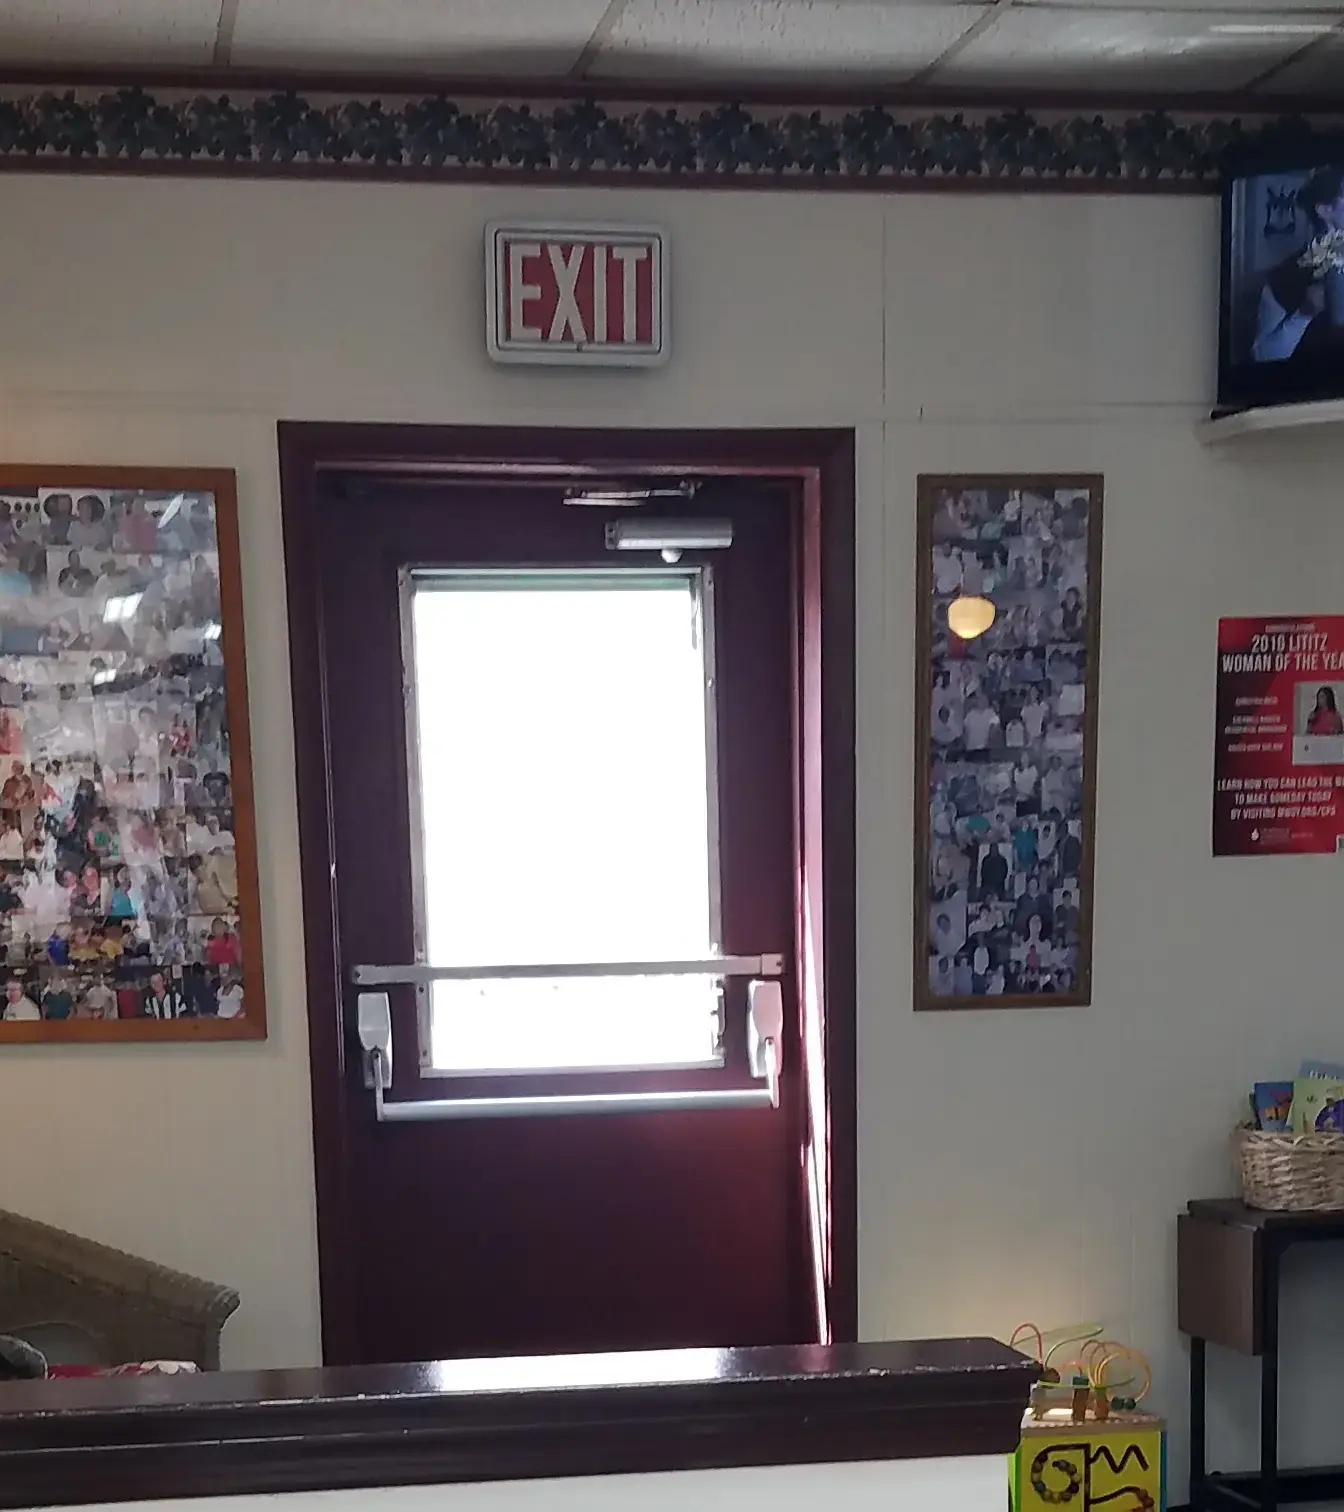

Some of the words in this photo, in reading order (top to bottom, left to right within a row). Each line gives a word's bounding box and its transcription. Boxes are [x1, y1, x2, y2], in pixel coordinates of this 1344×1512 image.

[509, 243, 648, 344] EXIT
[1289, 633, 1328, 652] LITITZ
[1222, 654, 1272, 673] WOMAN
[1275, 653, 1290, 672] OF
[1295, 652, 1319, 672] THE
[1217, 779, 1243, 791] LEARN
[1263, 778, 1279, 790] YOU
[1280, 777, 1296, 789] CAN
[1235, 793, 1244, 805] TO
[1246, 792, 1268, 804] MAKE
[1242, 807, 1276, 820] VISITING
